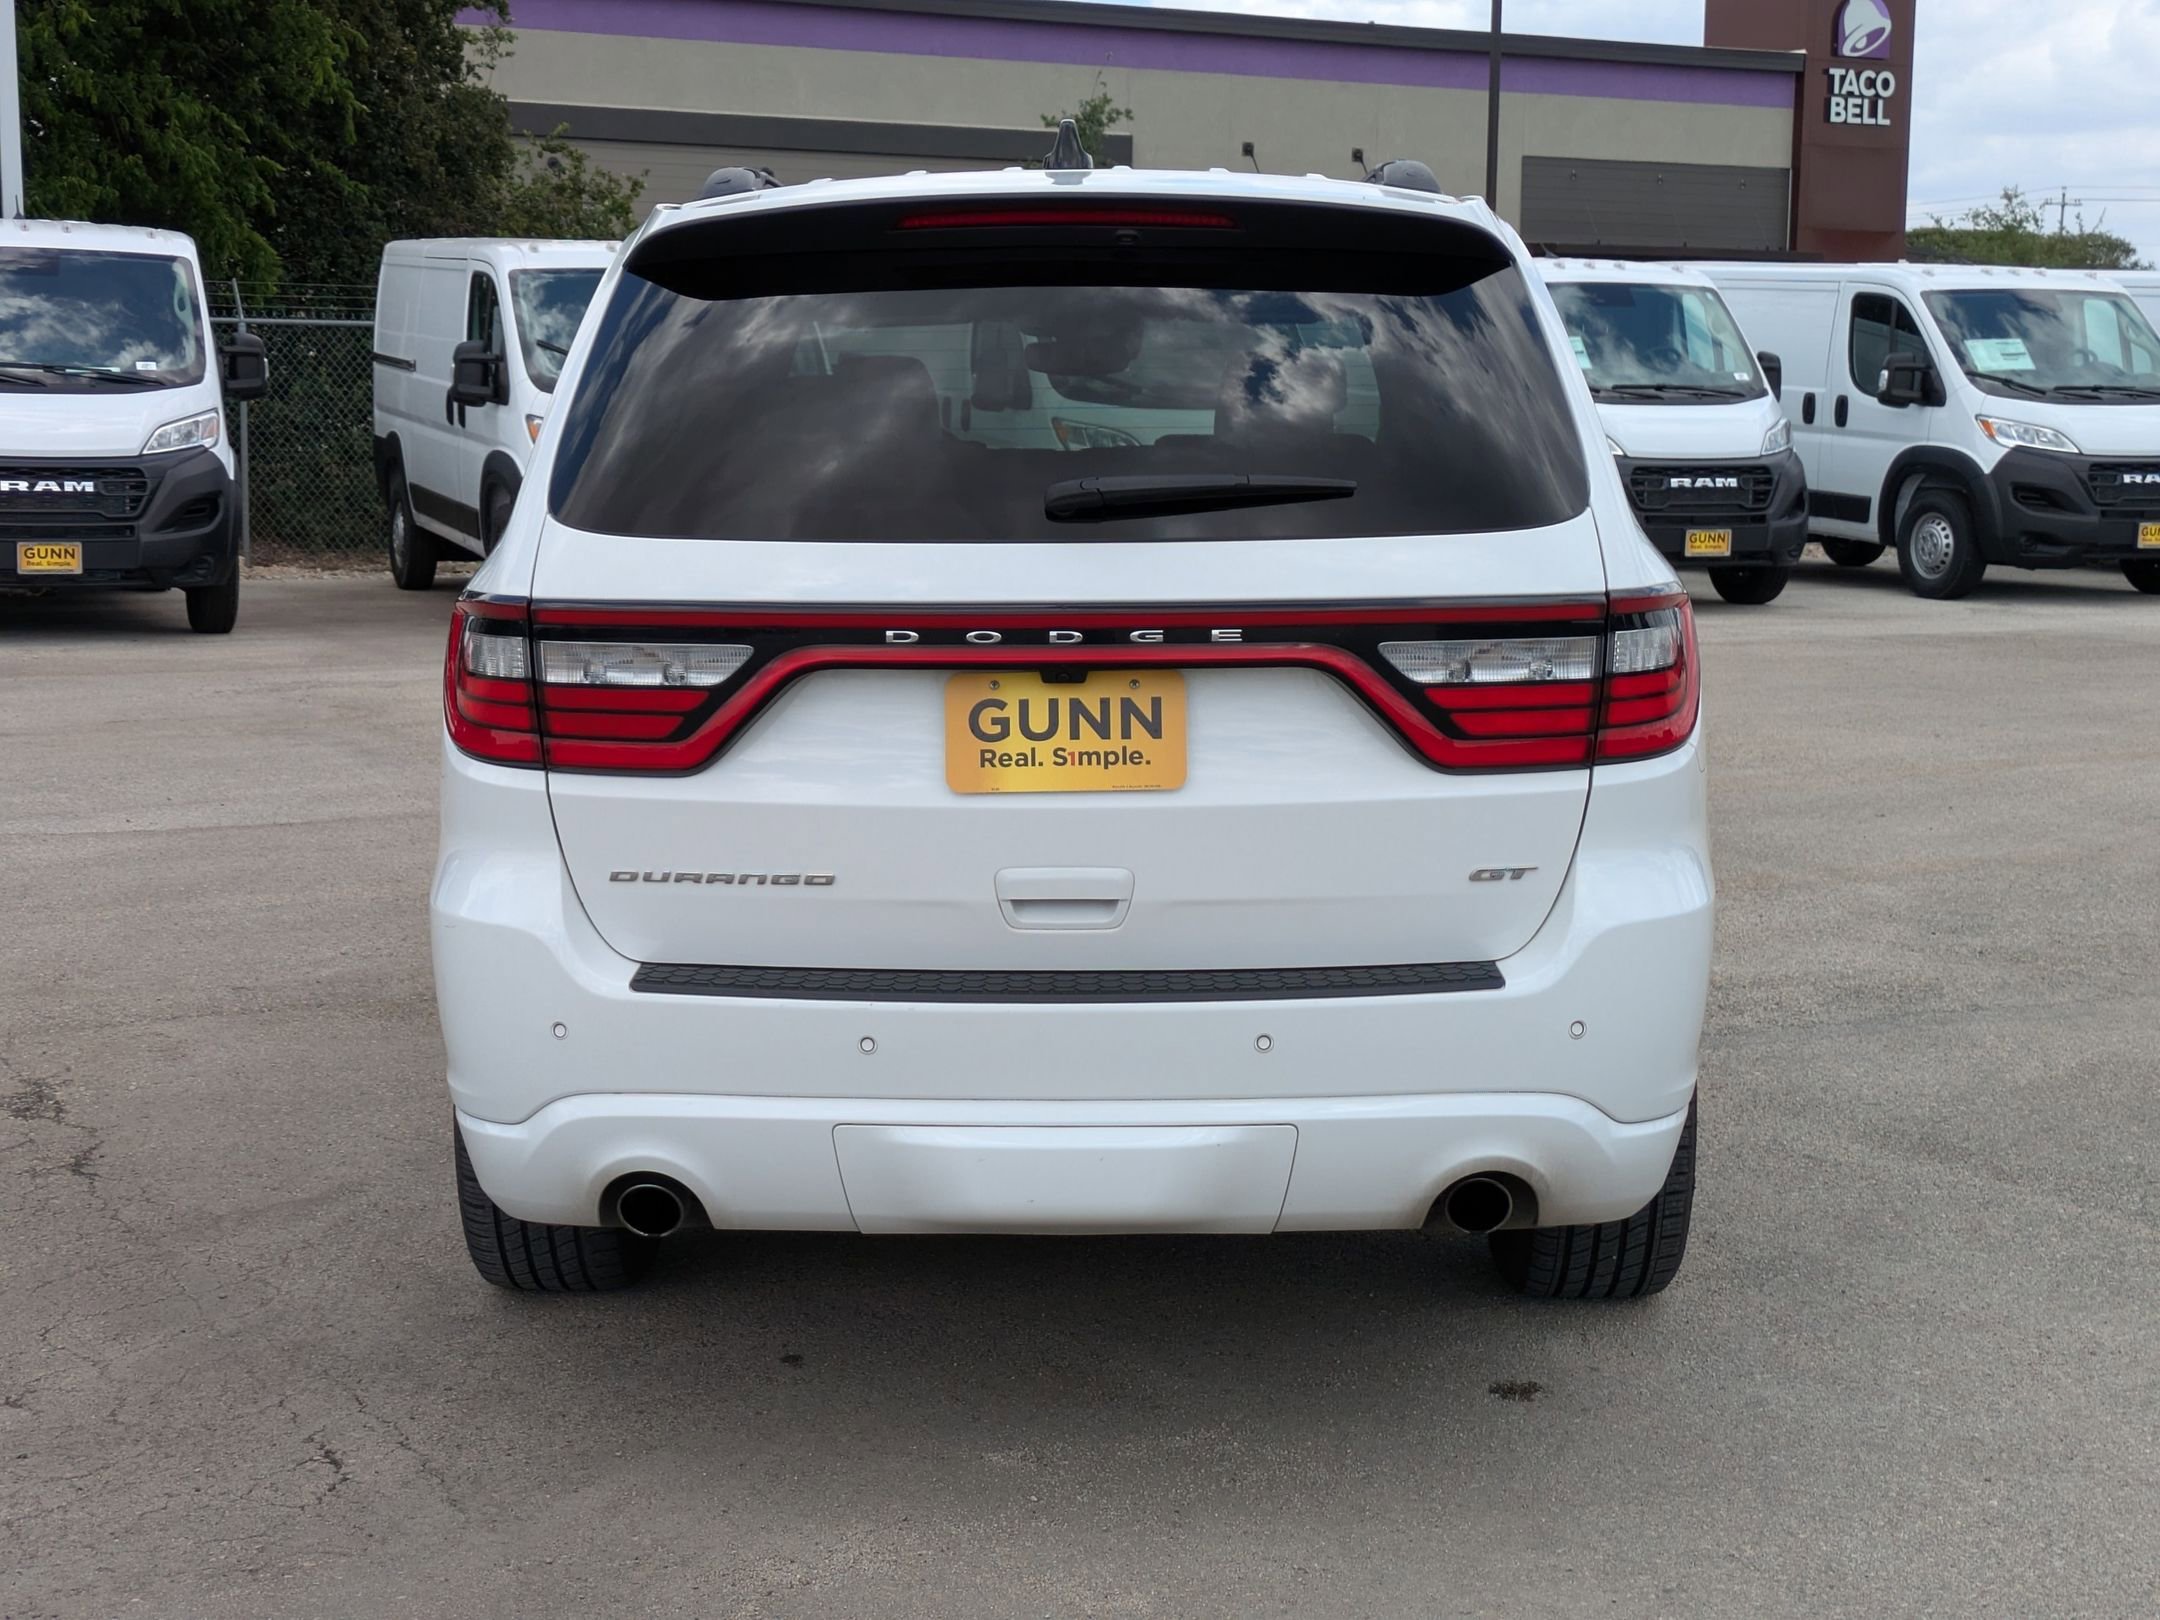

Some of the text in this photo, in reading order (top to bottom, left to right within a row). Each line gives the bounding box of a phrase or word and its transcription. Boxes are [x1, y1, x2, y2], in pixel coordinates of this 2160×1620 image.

[1828, 67, 1896, 98] TACO
[1829, 96, 1891, 126] BELL
[0, 480, 94, 492] RAM
[1670, 477, 1738, 488] RAM
[1689, 532, 1726, 544] GUNN
[2141, 526, 2160, 537] GU
[24, 547, 76, 560] GUNN
[885, 629, 1243, 644] DODGE
[968, 696, 1163, 743] GUNN
[979, 747, 1044, 768] Real.
[609, 870, 835, 886] DURANGO
[1468, 865, 1539, 882] GT
